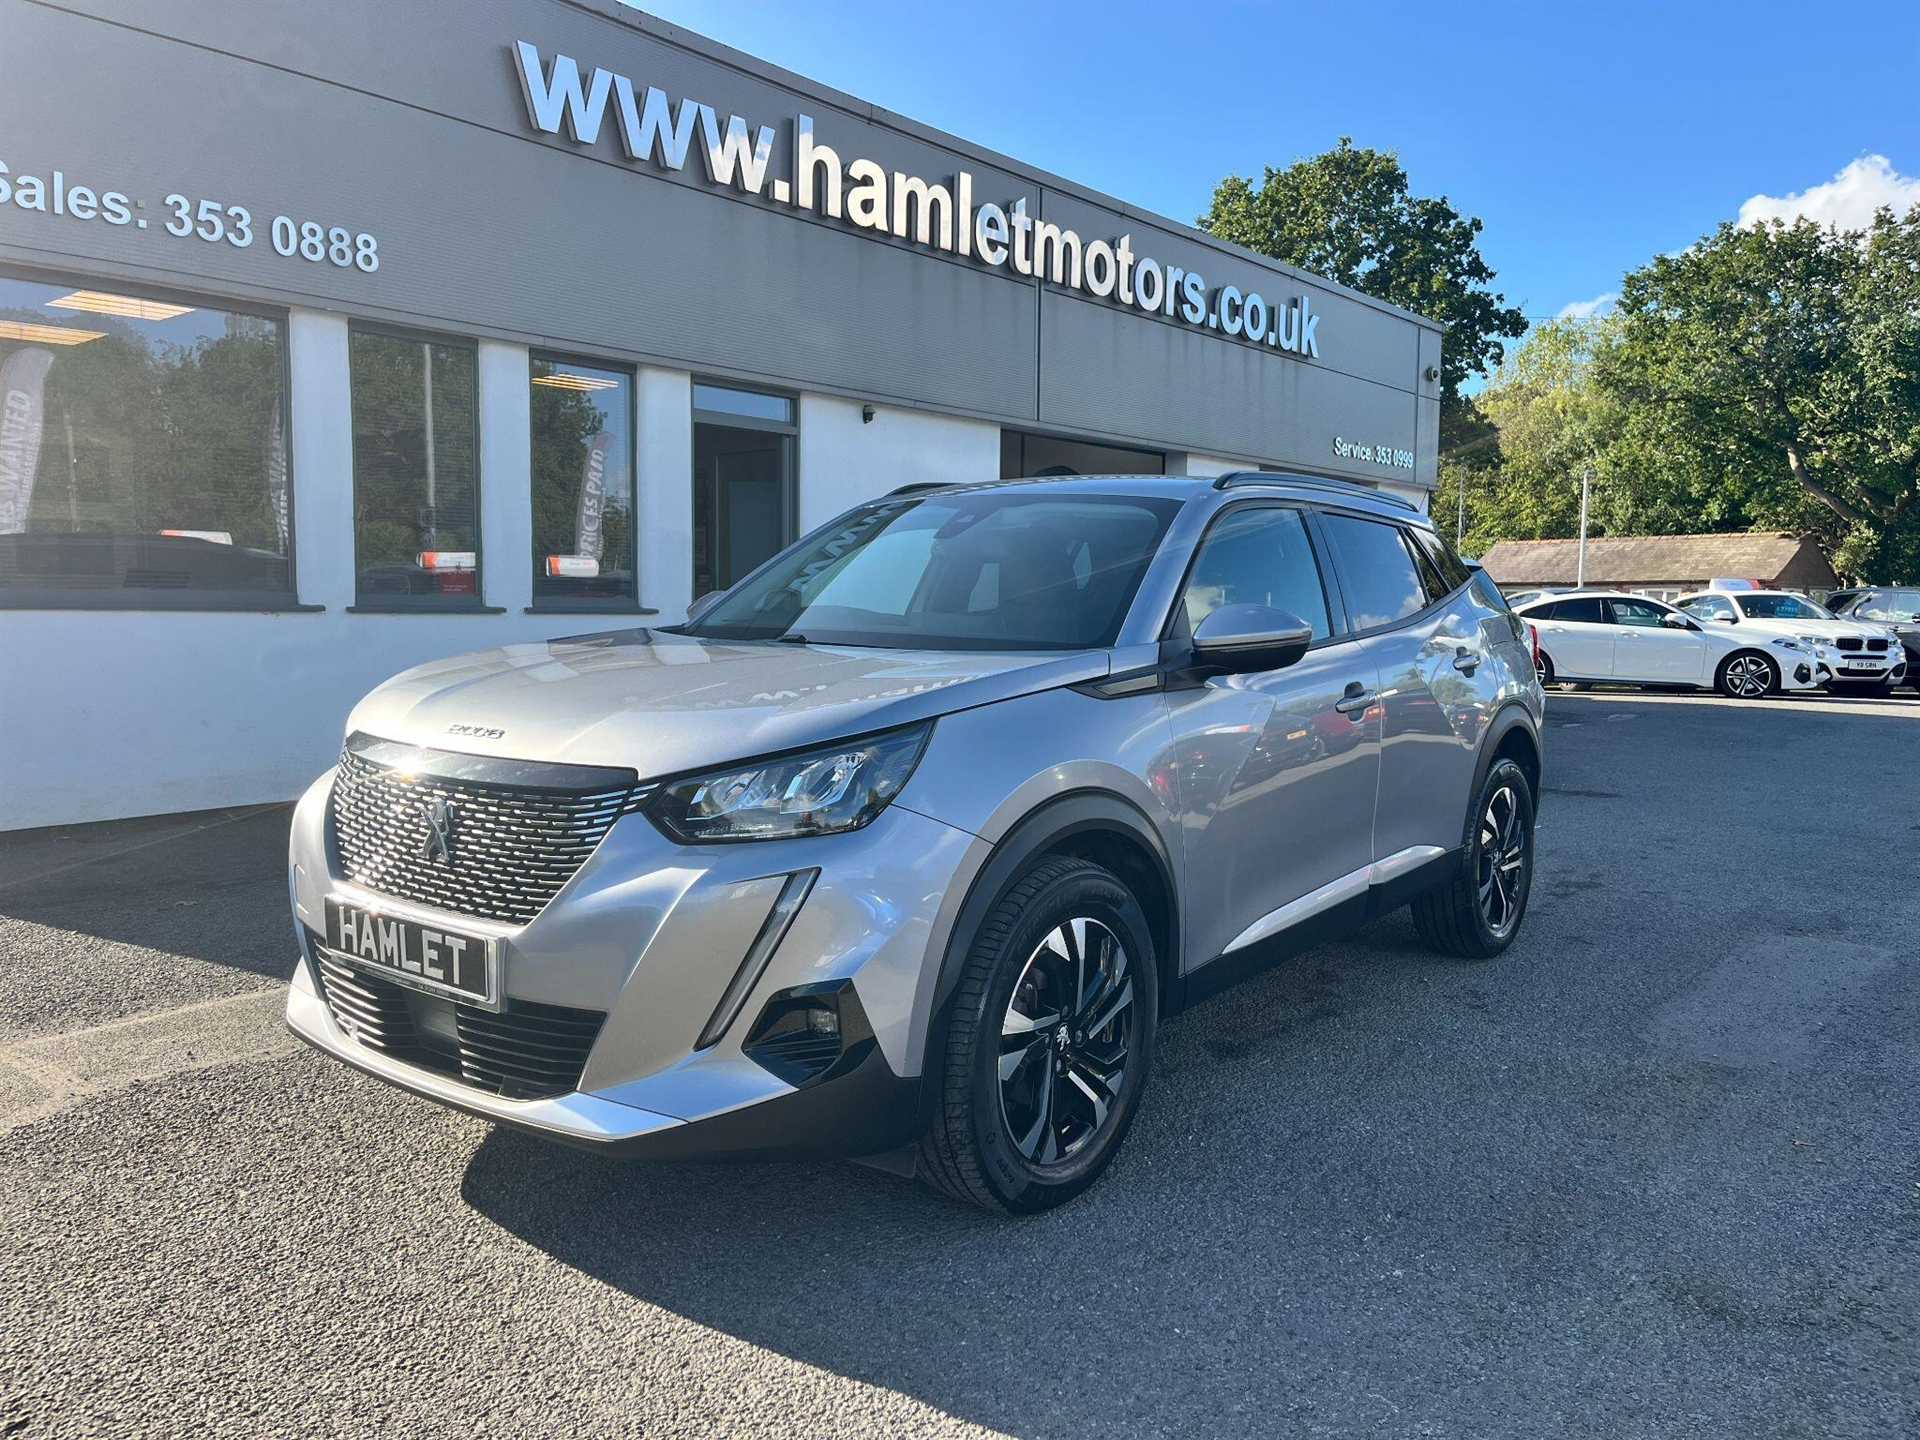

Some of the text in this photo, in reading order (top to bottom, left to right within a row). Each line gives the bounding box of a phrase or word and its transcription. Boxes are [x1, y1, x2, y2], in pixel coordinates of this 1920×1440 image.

[164, 193, 253, 248] 353
[271, 215, 380, 273] 0888
[512, 40, 1320, 359] www.hamletmotors.co.uk
[1375, 445, 1392, 466] 353
[1393, 449, 1414, 469] 0999
[338, 905, 467, 986] HAMLET
